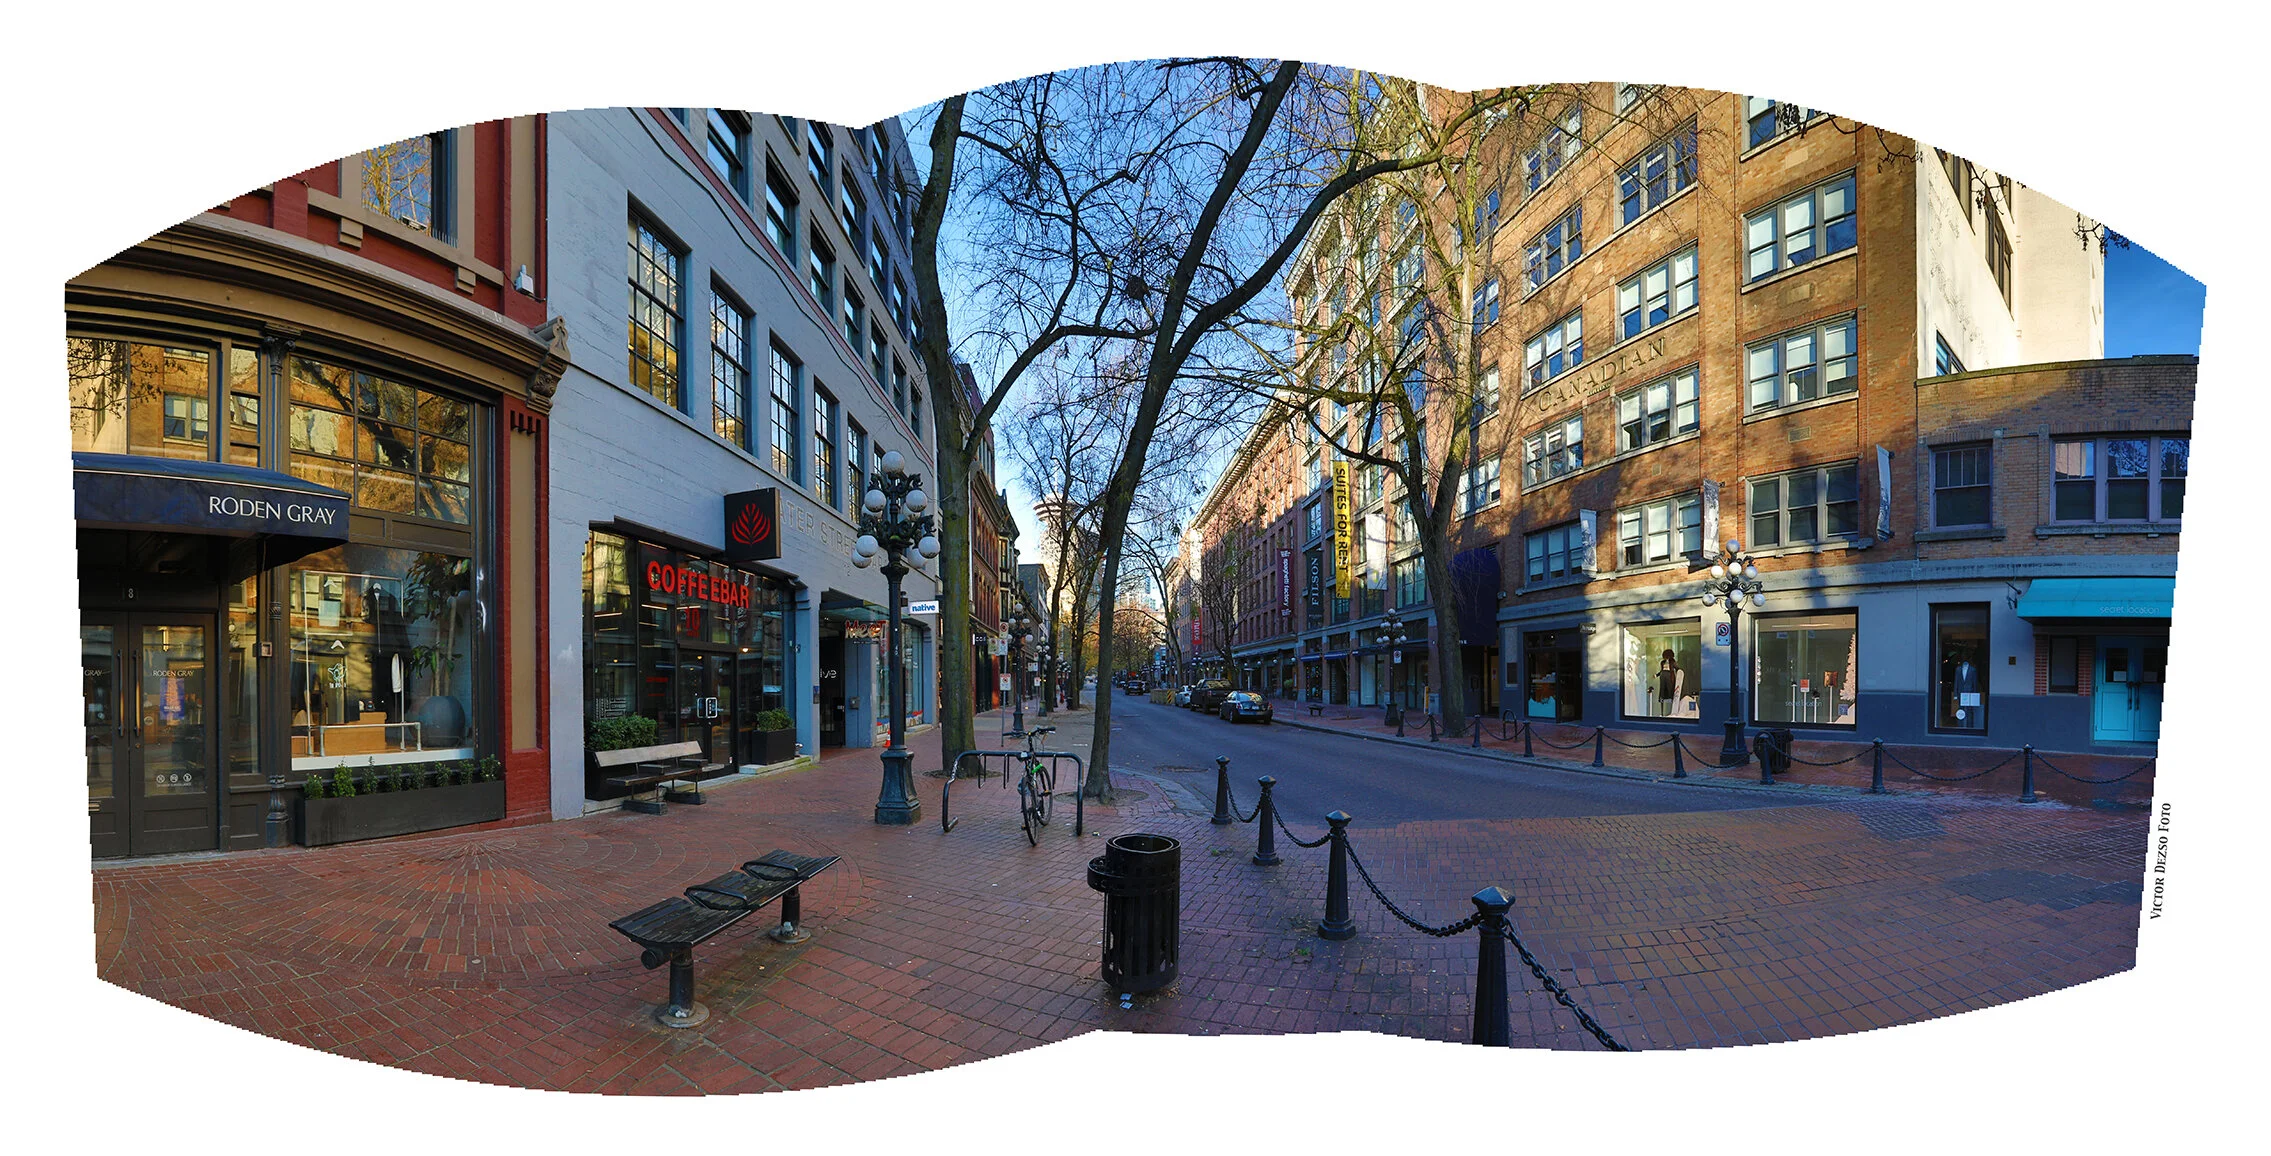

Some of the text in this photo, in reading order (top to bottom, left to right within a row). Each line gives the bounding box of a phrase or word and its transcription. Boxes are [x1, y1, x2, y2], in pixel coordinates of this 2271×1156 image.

[1539, 336, 1665, 411] CANADIAN
[209, 496, 336, 525] RODEN GRAY
[1335, 467, 1349, 573] SUITES FOR RENT
[780, 496, 857, 557] ATER STREE
[128, 588, 134, 599] 8
[1311, 557, 1319, 606] FILSON
[912, 603, 936, 612] native
[2100, 604, 2160, 615] secret location
[84, 669, 103, 677] GRAY
